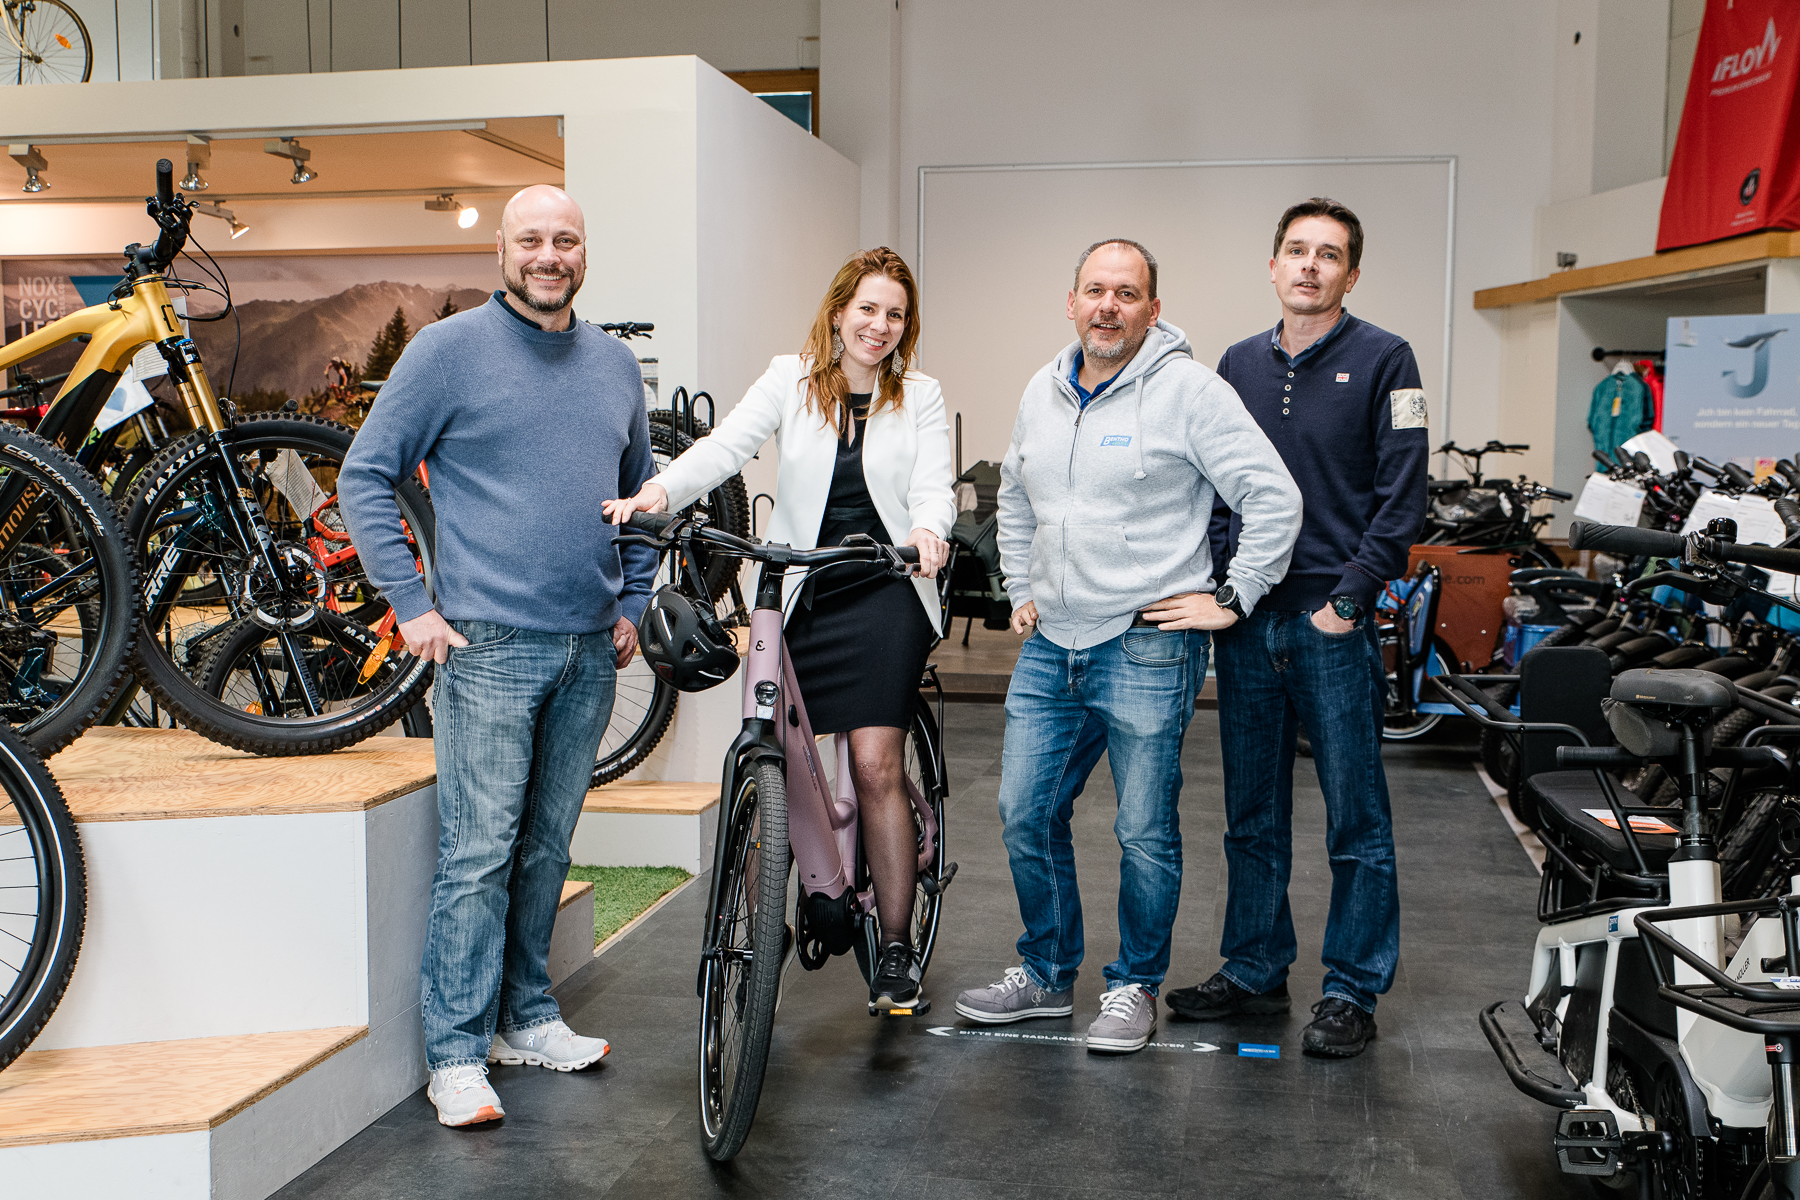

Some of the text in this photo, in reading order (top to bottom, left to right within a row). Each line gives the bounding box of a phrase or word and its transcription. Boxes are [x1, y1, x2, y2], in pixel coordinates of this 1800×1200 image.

[18, 276, 58, 297] NOX
[19, 298, 58, 319] CYC
[4, 443, 105, 537] CONTINENTAL
[144, 443, 207, 506] MAXXIS
[342, 625, 399, 673] MAXIS
